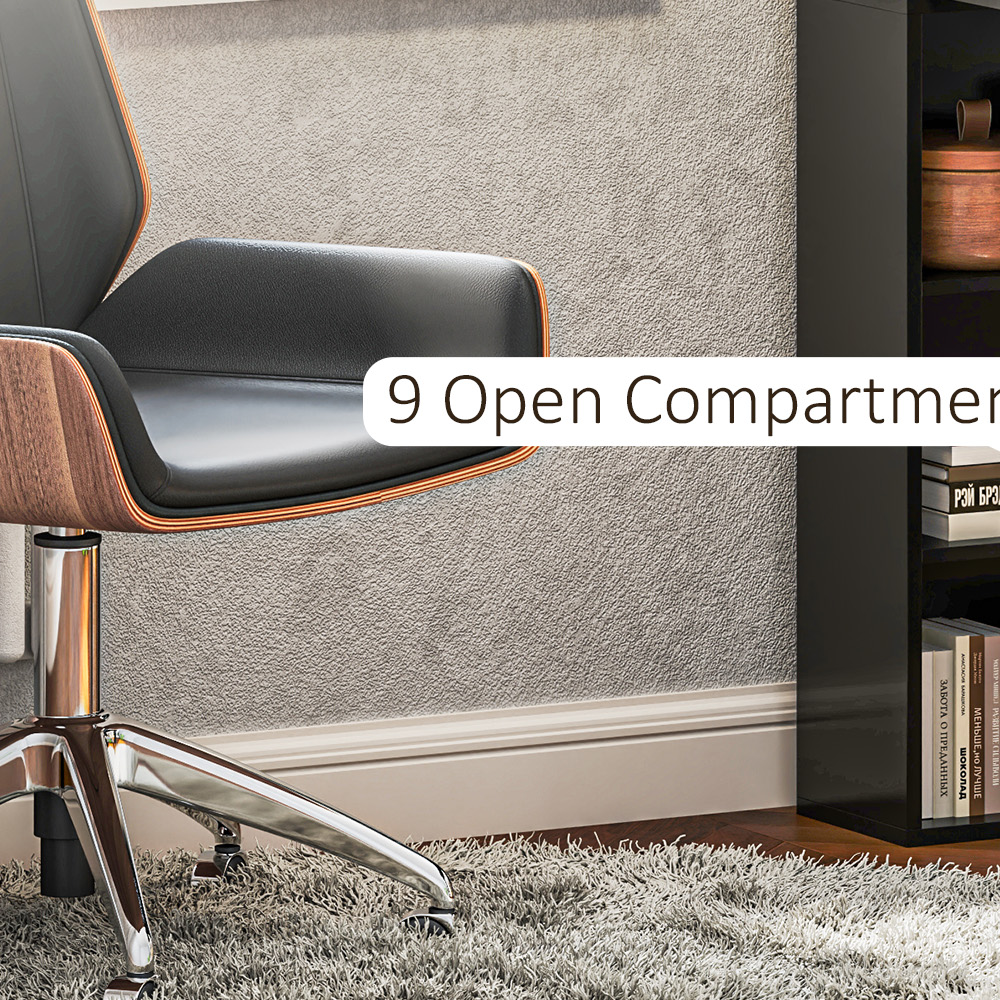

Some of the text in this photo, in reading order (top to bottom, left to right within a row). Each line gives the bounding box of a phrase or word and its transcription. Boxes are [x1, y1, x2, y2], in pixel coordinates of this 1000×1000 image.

[954, 483, 975, 508] РЭЙ
[940, 679, 948, 718] ЗАБОТА
[940, 732, 948, 797] ПРЕДАННЫХ
[959, 747, 967, 800] ШОКОЛАД
[973, 765, 982, 800] ЛУЧШЕ
